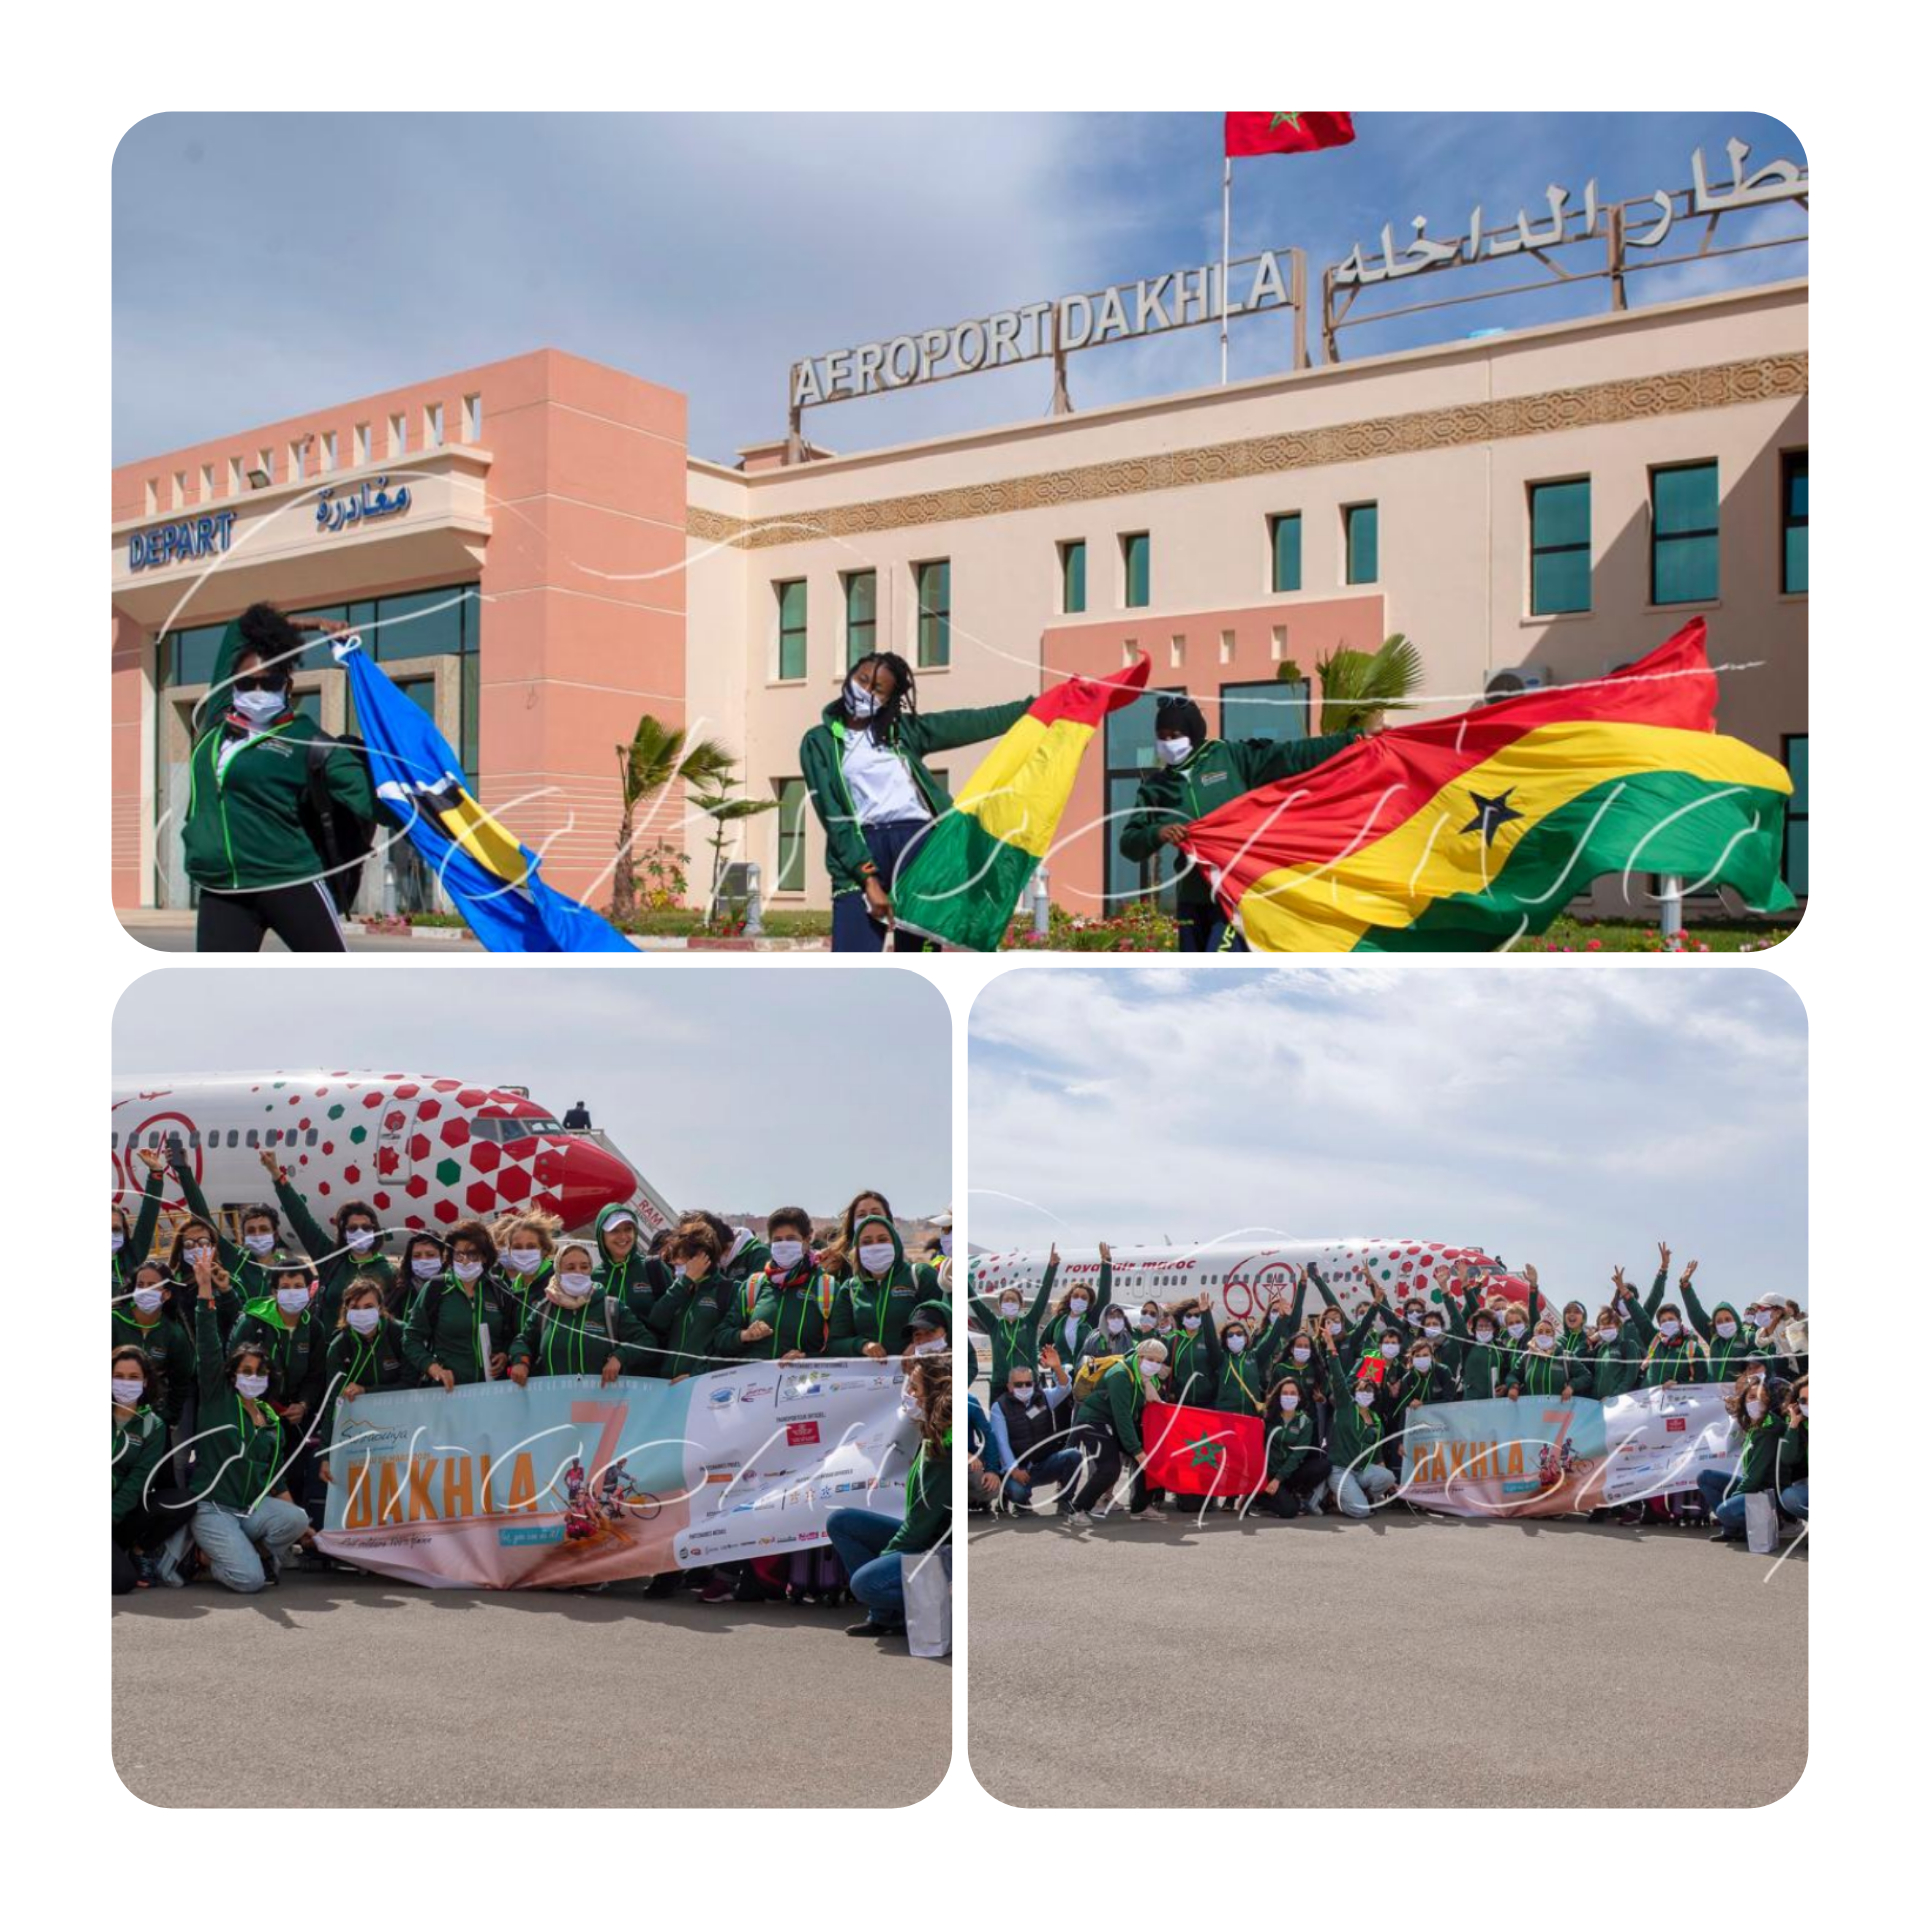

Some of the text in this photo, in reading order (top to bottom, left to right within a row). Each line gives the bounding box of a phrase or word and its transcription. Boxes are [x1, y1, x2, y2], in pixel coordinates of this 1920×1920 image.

[793, 250, 1289, 406] AEROPORT DAKHLA
[316, 476, 411, 531] مغادرة
[129, 511, 237, 571] DEPART
[1065, 1262, 1101, 1274] roya
[570, 1400, 630, 1497] 7
[1542, 1410, 1575, 1453] 7
[1413, 1441, 1524, 1482] DAKHLA
[346, 1452, 538, 1529] DAKHLA
